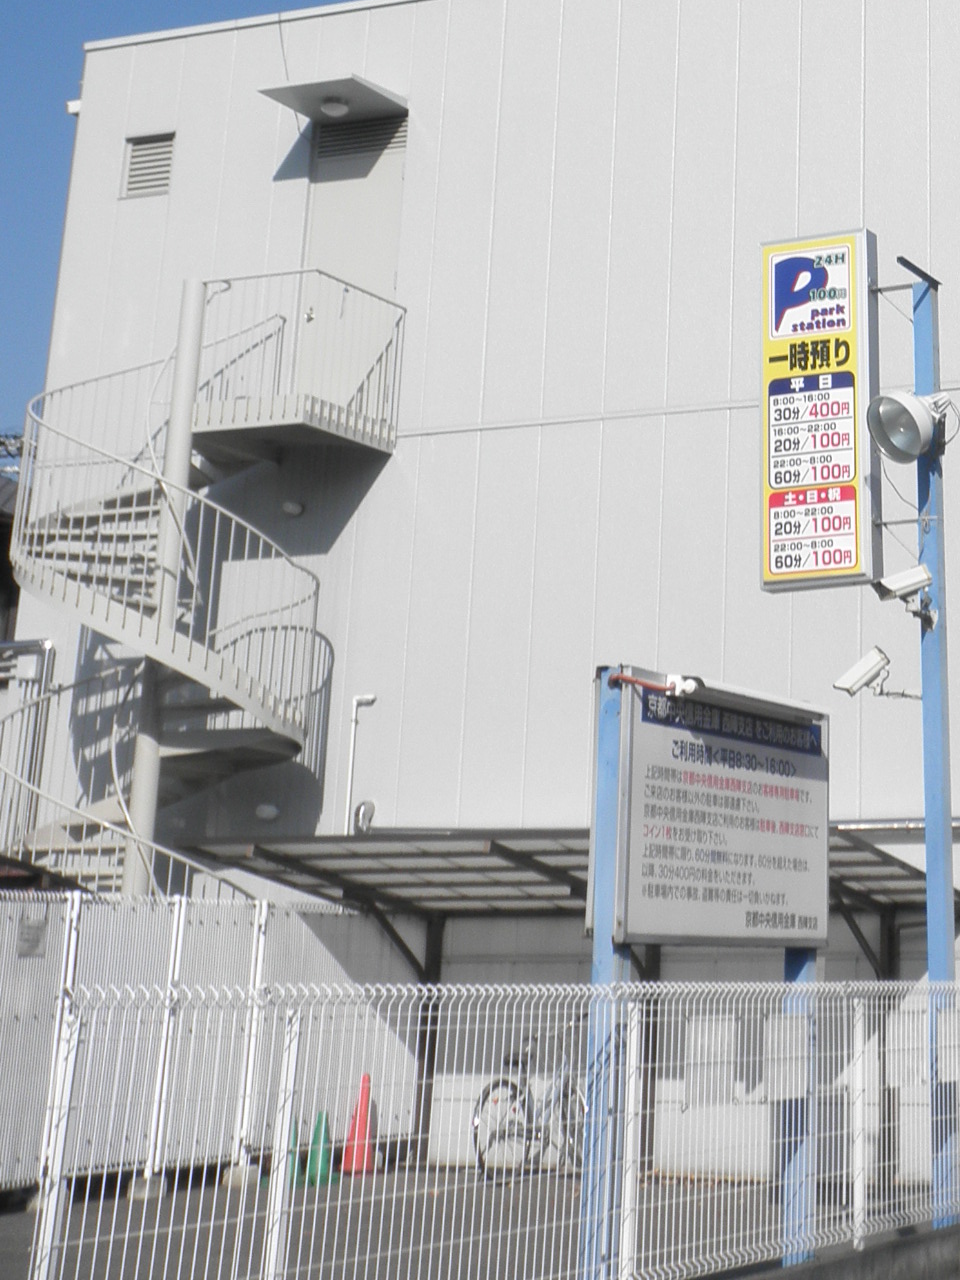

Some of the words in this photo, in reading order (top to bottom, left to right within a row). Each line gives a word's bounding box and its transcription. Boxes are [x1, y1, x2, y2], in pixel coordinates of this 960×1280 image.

[814, 253, 846, 267] 24H
[811, 304, 845, 321] park
[791, 318, 846, 333] station
[768, 338, 850, 371] 一時預り
[790, 374, 832, 392] 平日
